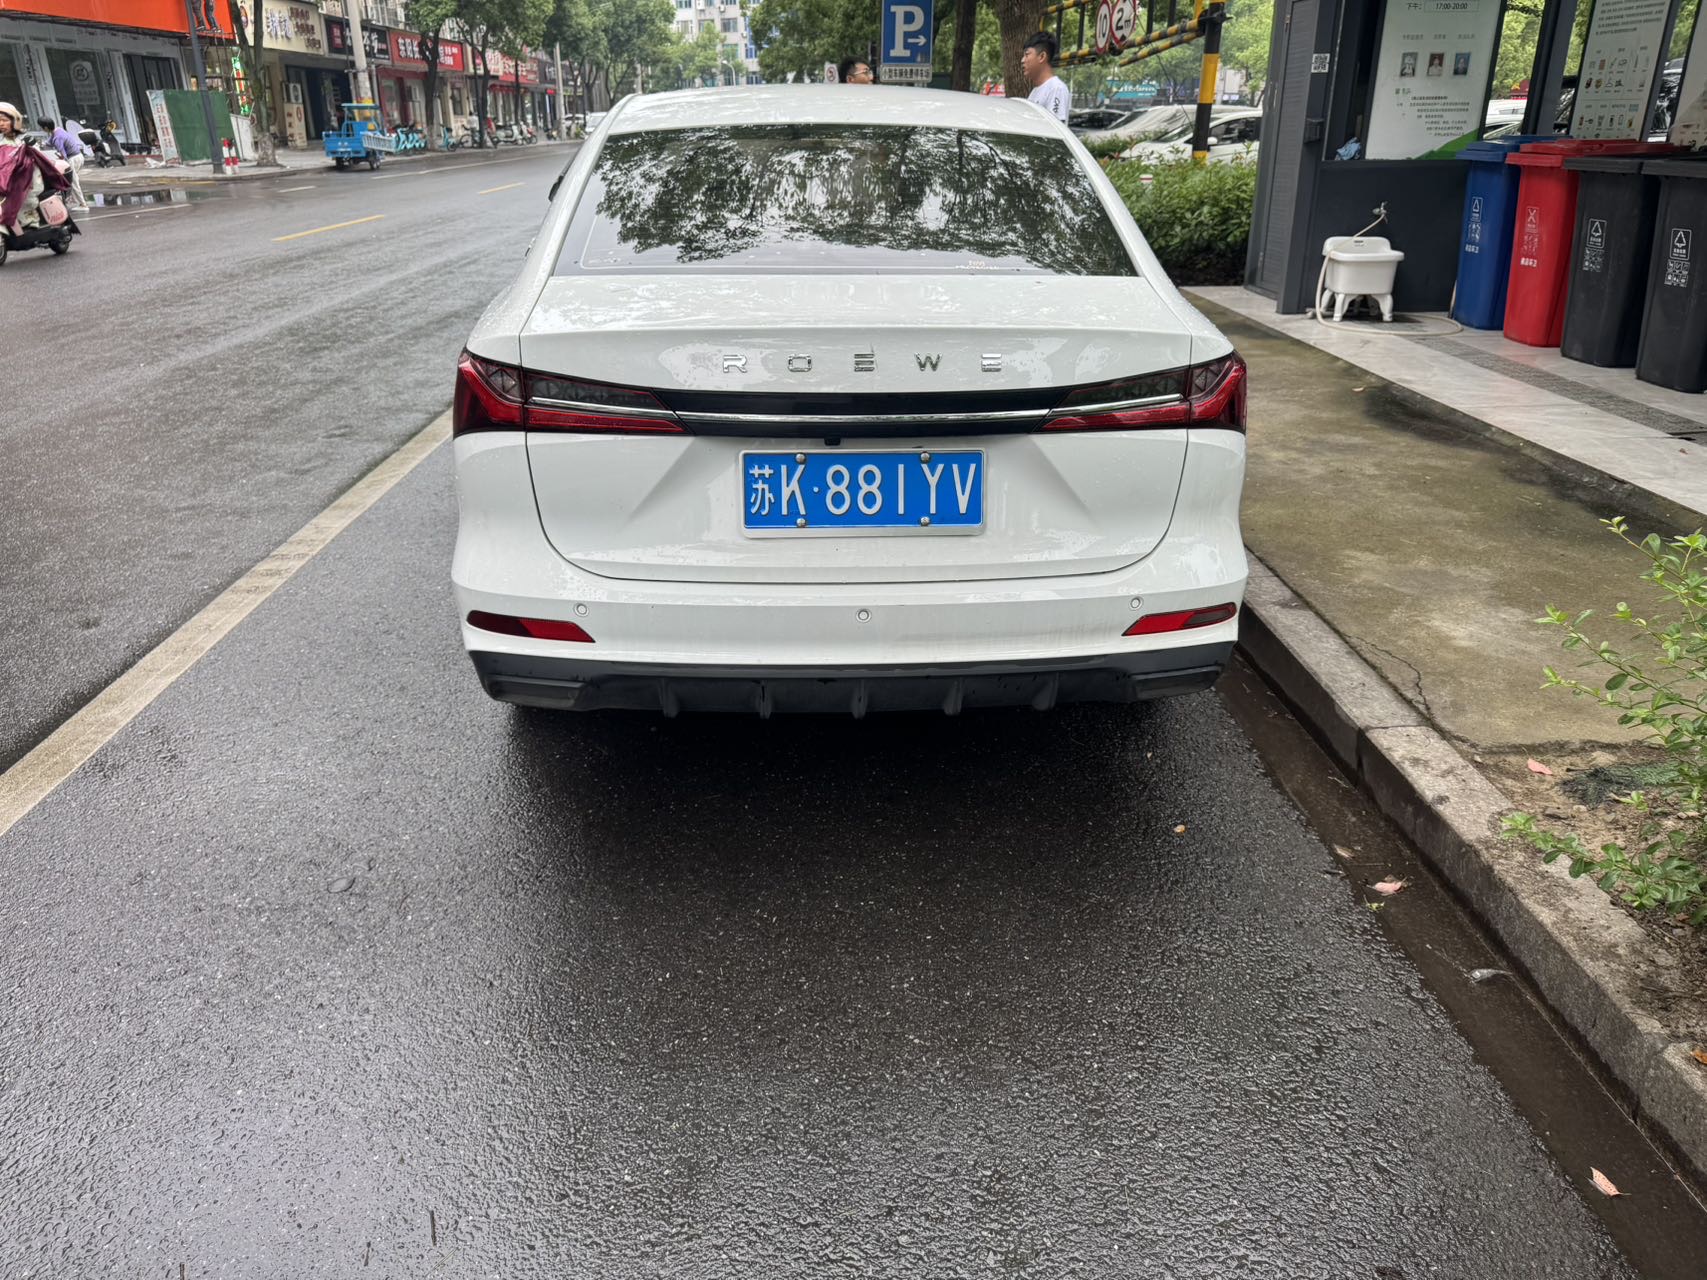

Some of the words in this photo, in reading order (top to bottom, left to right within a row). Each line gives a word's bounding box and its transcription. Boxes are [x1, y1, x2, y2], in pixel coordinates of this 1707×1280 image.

[890, 5, 924, 56] P
[1099, 13, 1107, 38] 10
[722, 353, 1002, 373] ROEWE
